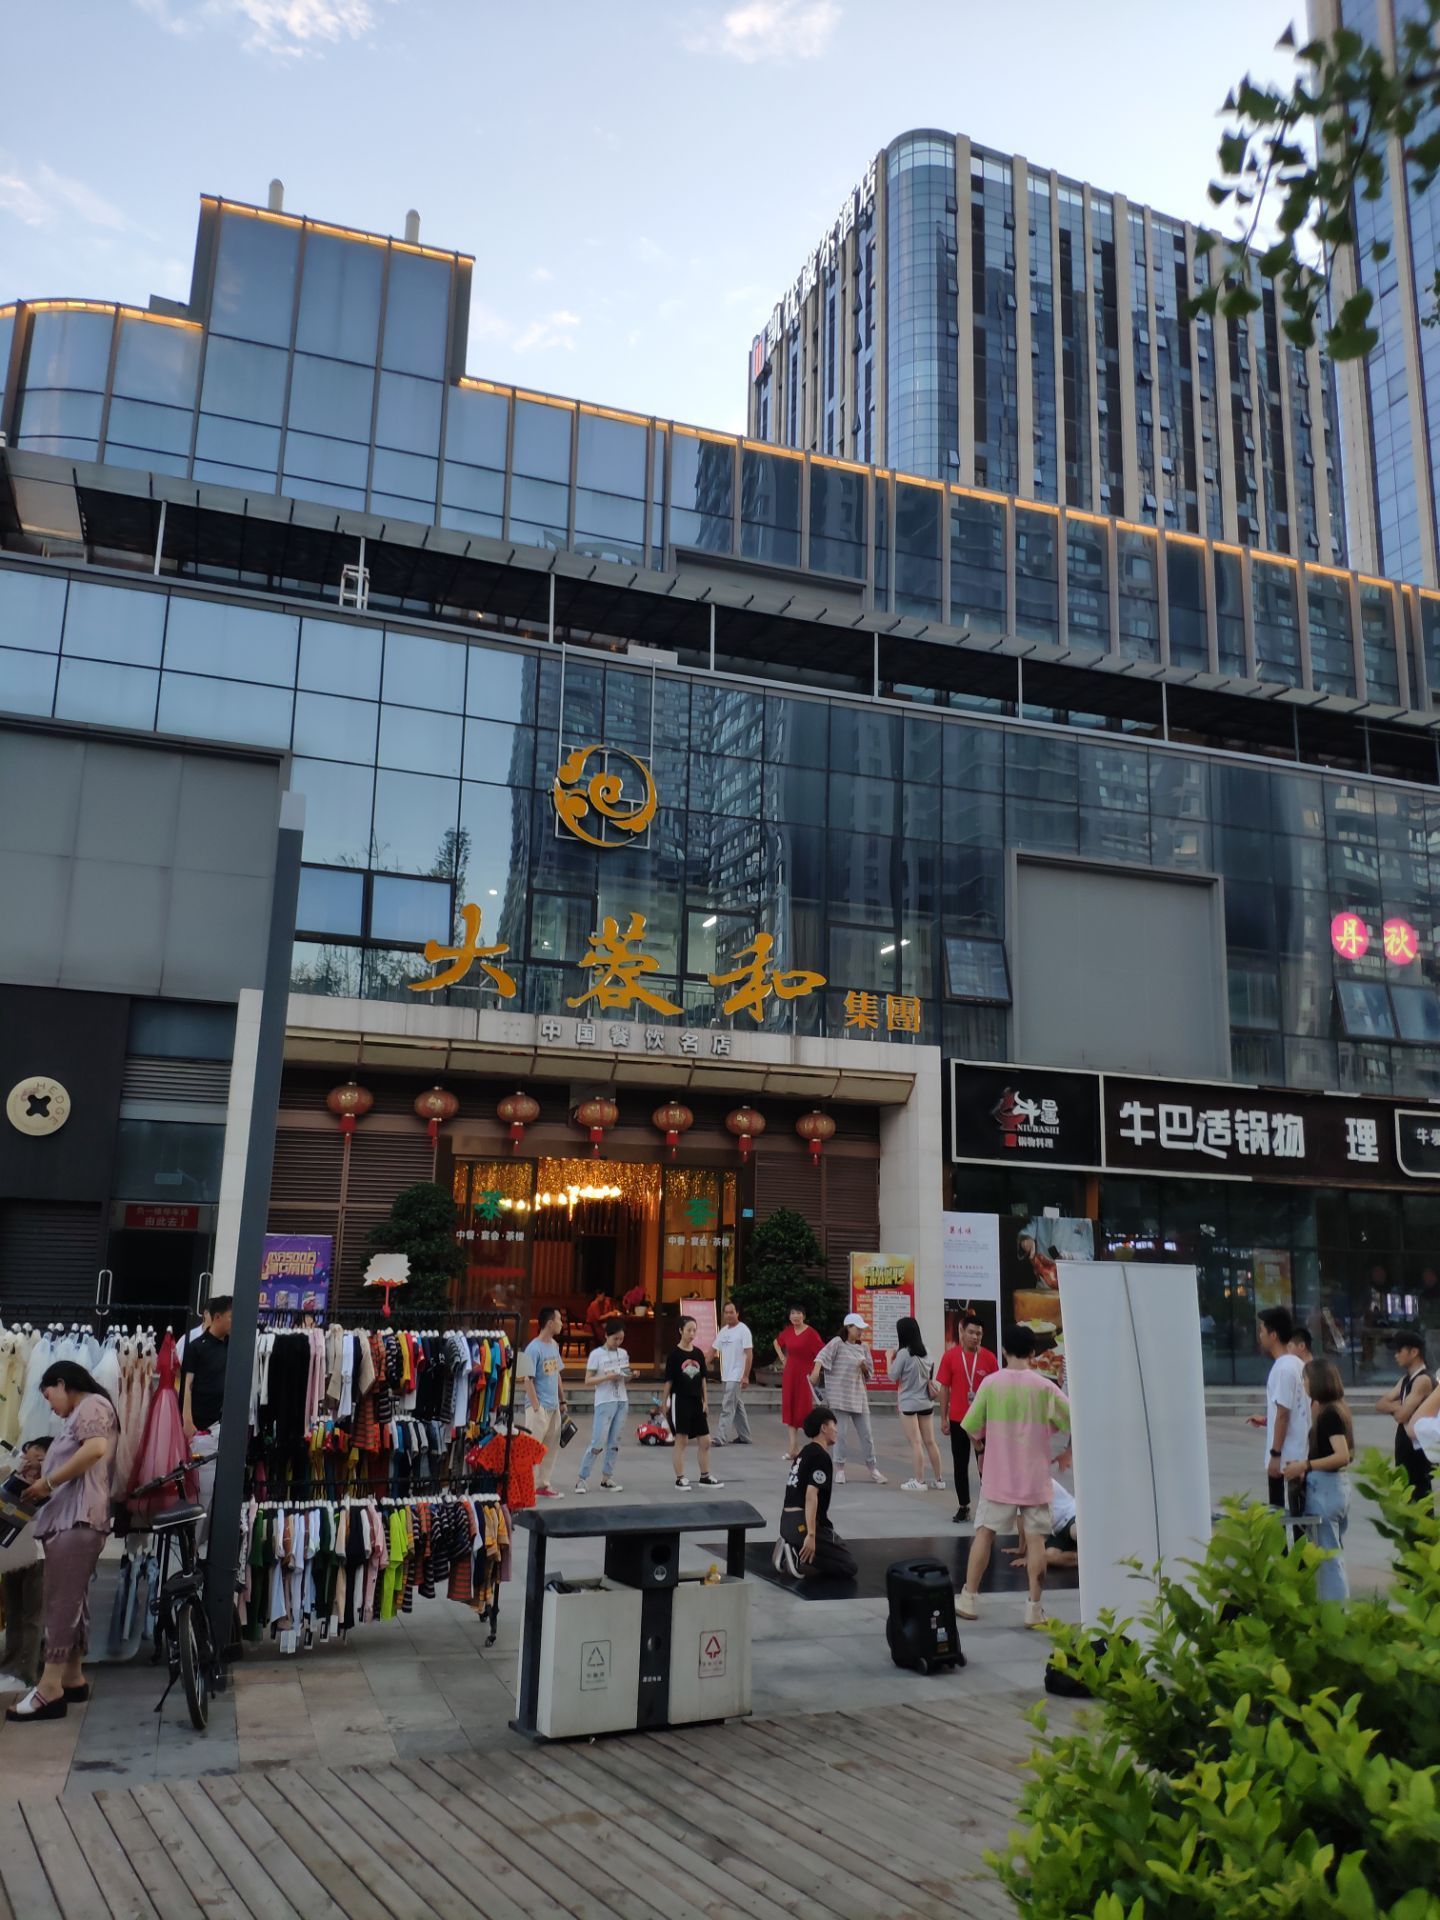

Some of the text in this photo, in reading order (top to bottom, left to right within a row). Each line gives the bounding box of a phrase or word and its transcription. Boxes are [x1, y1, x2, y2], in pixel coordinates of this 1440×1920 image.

[407, 902, 827, 1023] 大蓉和
[541, 1020, 732, 1056] 中国餐饮名店
[1017, 1123, 1060, 1135] NIUBASHI
[1345, 1117, 1380, 1163] 理
